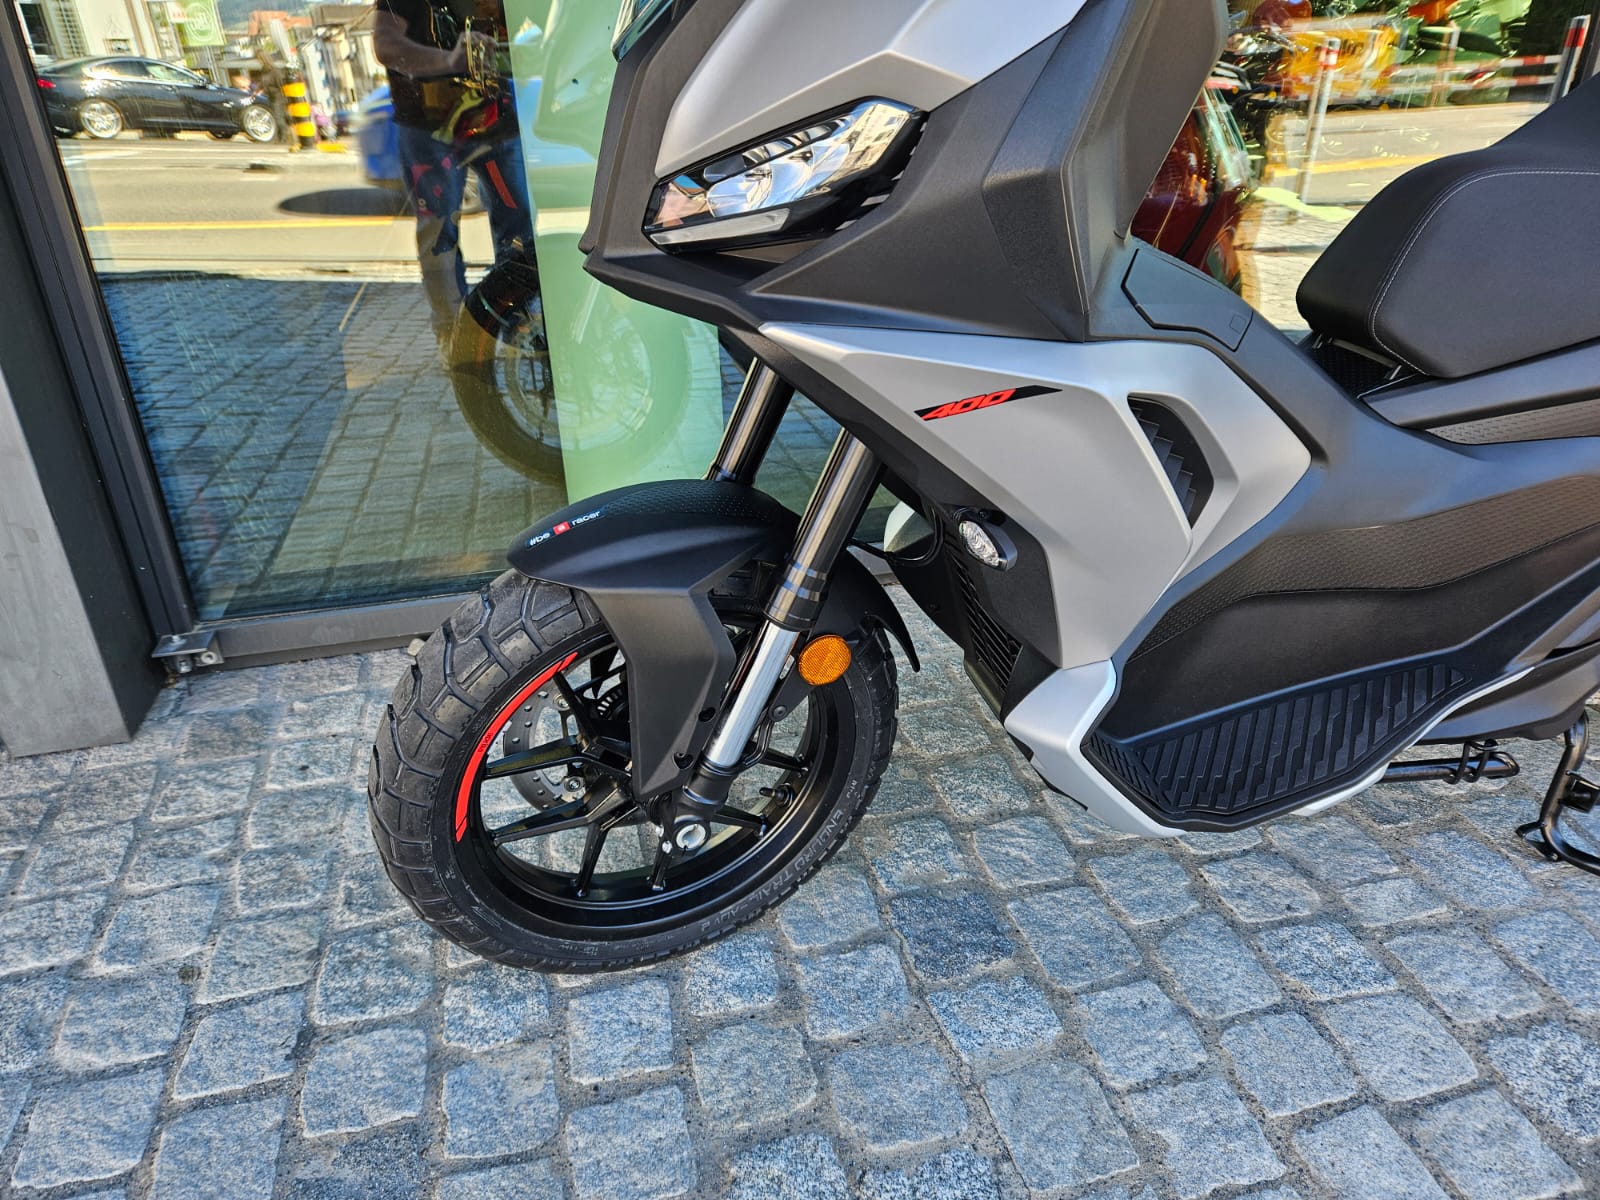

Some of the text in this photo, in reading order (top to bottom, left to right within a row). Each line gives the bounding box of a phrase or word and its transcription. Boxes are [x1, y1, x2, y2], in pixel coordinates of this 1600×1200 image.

[921, 388, 1017, 420] 400
[571, 511, 601, 525] racer
[794, 808, 844, 871] ENDURO
